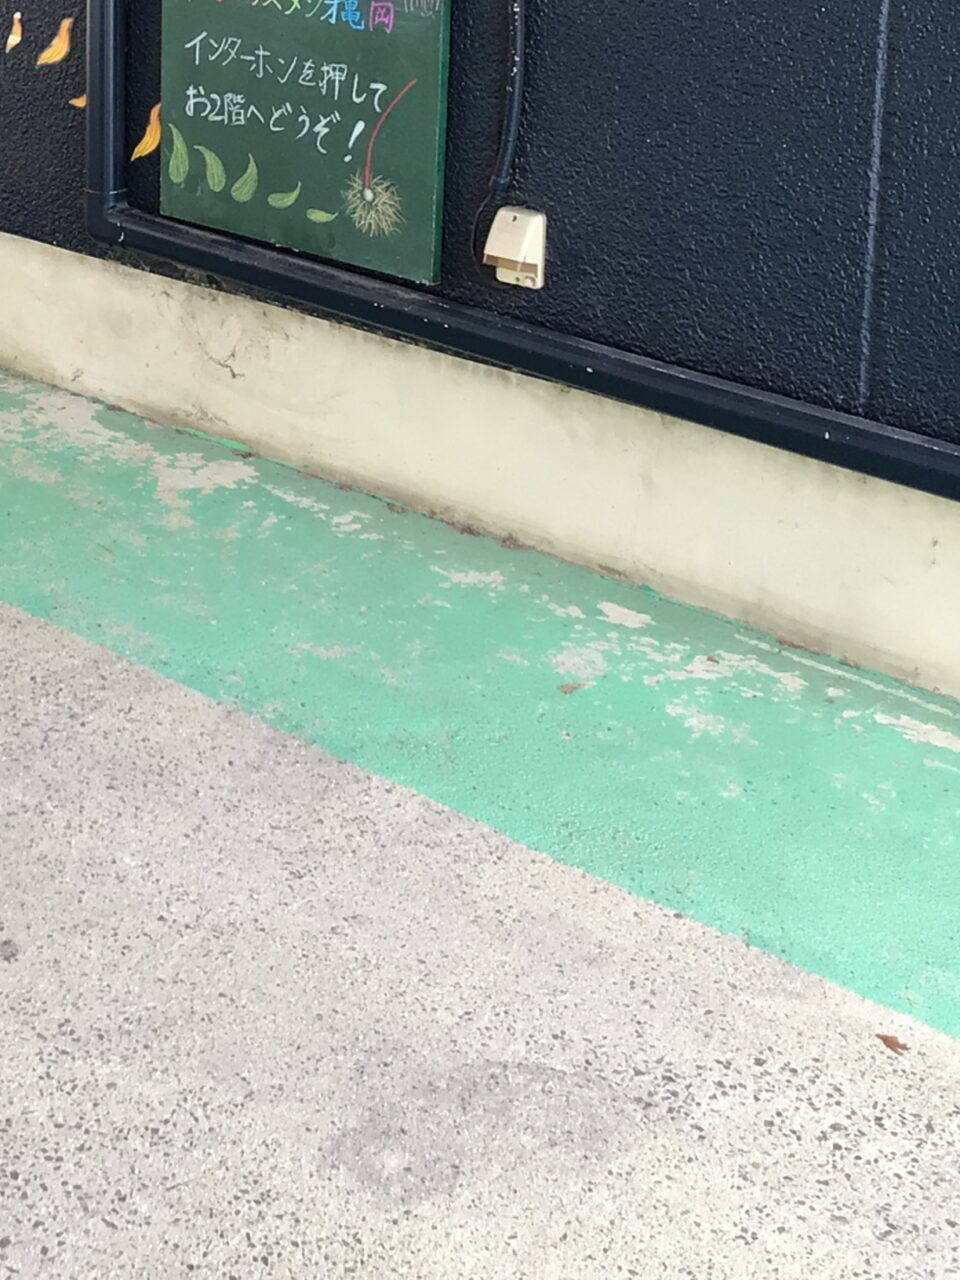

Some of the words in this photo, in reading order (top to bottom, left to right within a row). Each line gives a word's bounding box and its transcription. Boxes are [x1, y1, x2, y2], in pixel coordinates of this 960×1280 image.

[185, 32, 387, 112] インターホンを押して
